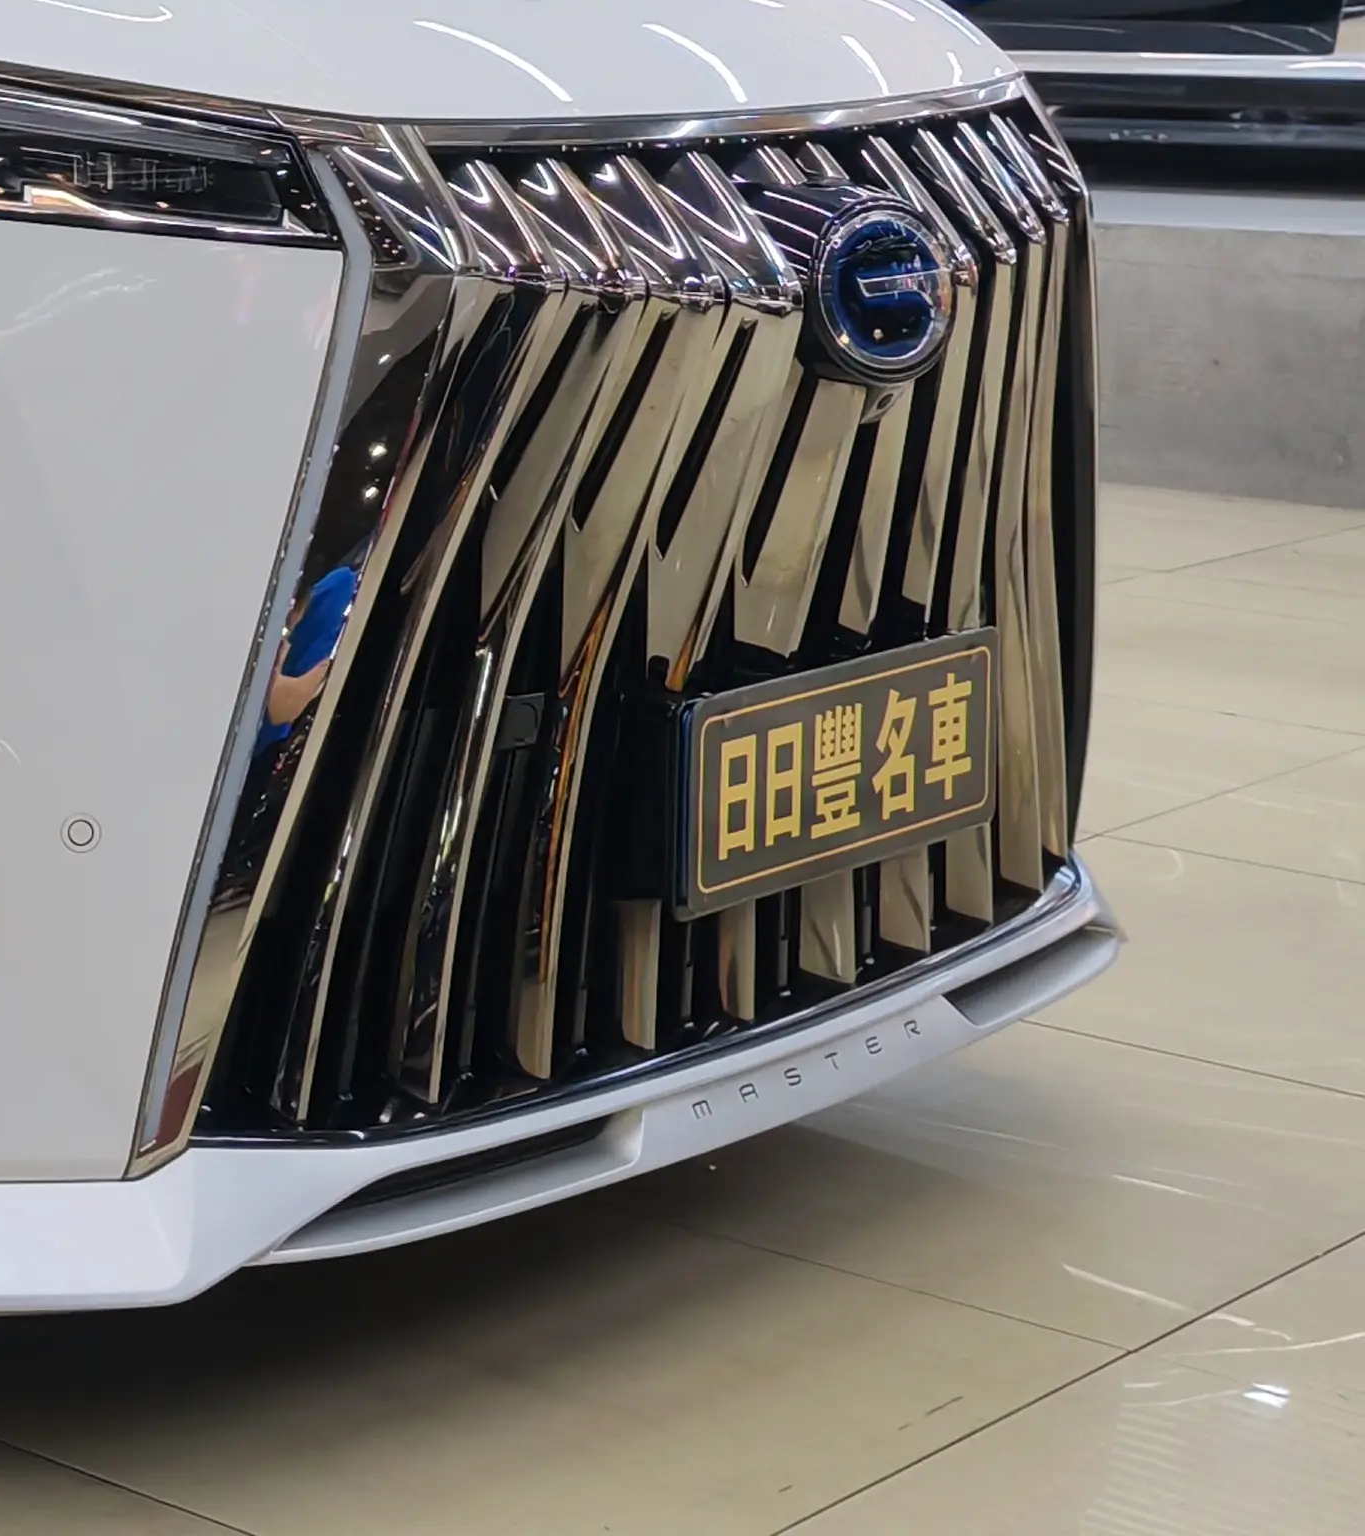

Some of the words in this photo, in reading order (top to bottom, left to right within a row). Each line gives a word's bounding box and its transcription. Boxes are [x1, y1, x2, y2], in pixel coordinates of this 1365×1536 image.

[718, 672, 973, 861] 日日豐名車
[691, 1018, 921, 1120] MASTER
